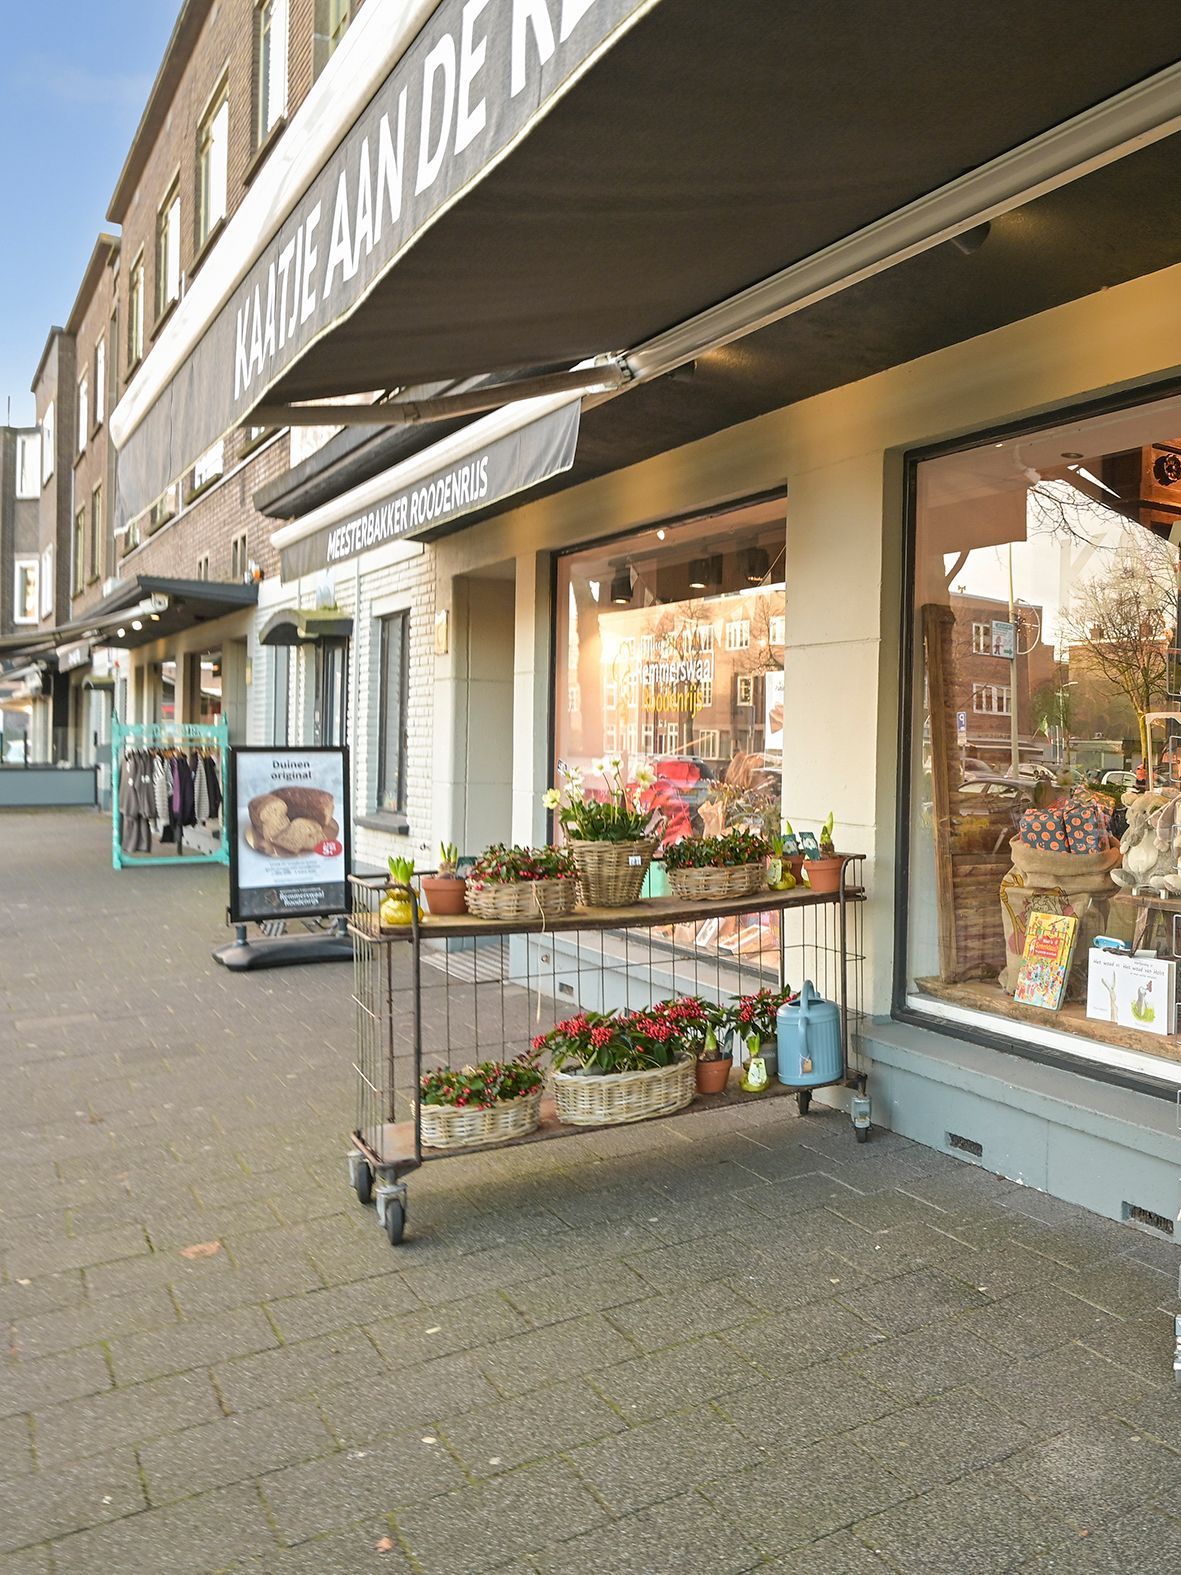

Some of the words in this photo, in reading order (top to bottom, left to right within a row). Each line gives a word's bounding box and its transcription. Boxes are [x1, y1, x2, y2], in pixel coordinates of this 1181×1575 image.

[234, 199, 322, 400] KAATJE
[323, 84, 408, 300] AAN
[415, 0, 488, 197] DE
[326, 496, 408, 562] MEESTERBAKKER
[409, 455, 489, 527] ROODENRIJS
[270, 772, 313, 780] original
[272, 760, 310, 769] Duinen
